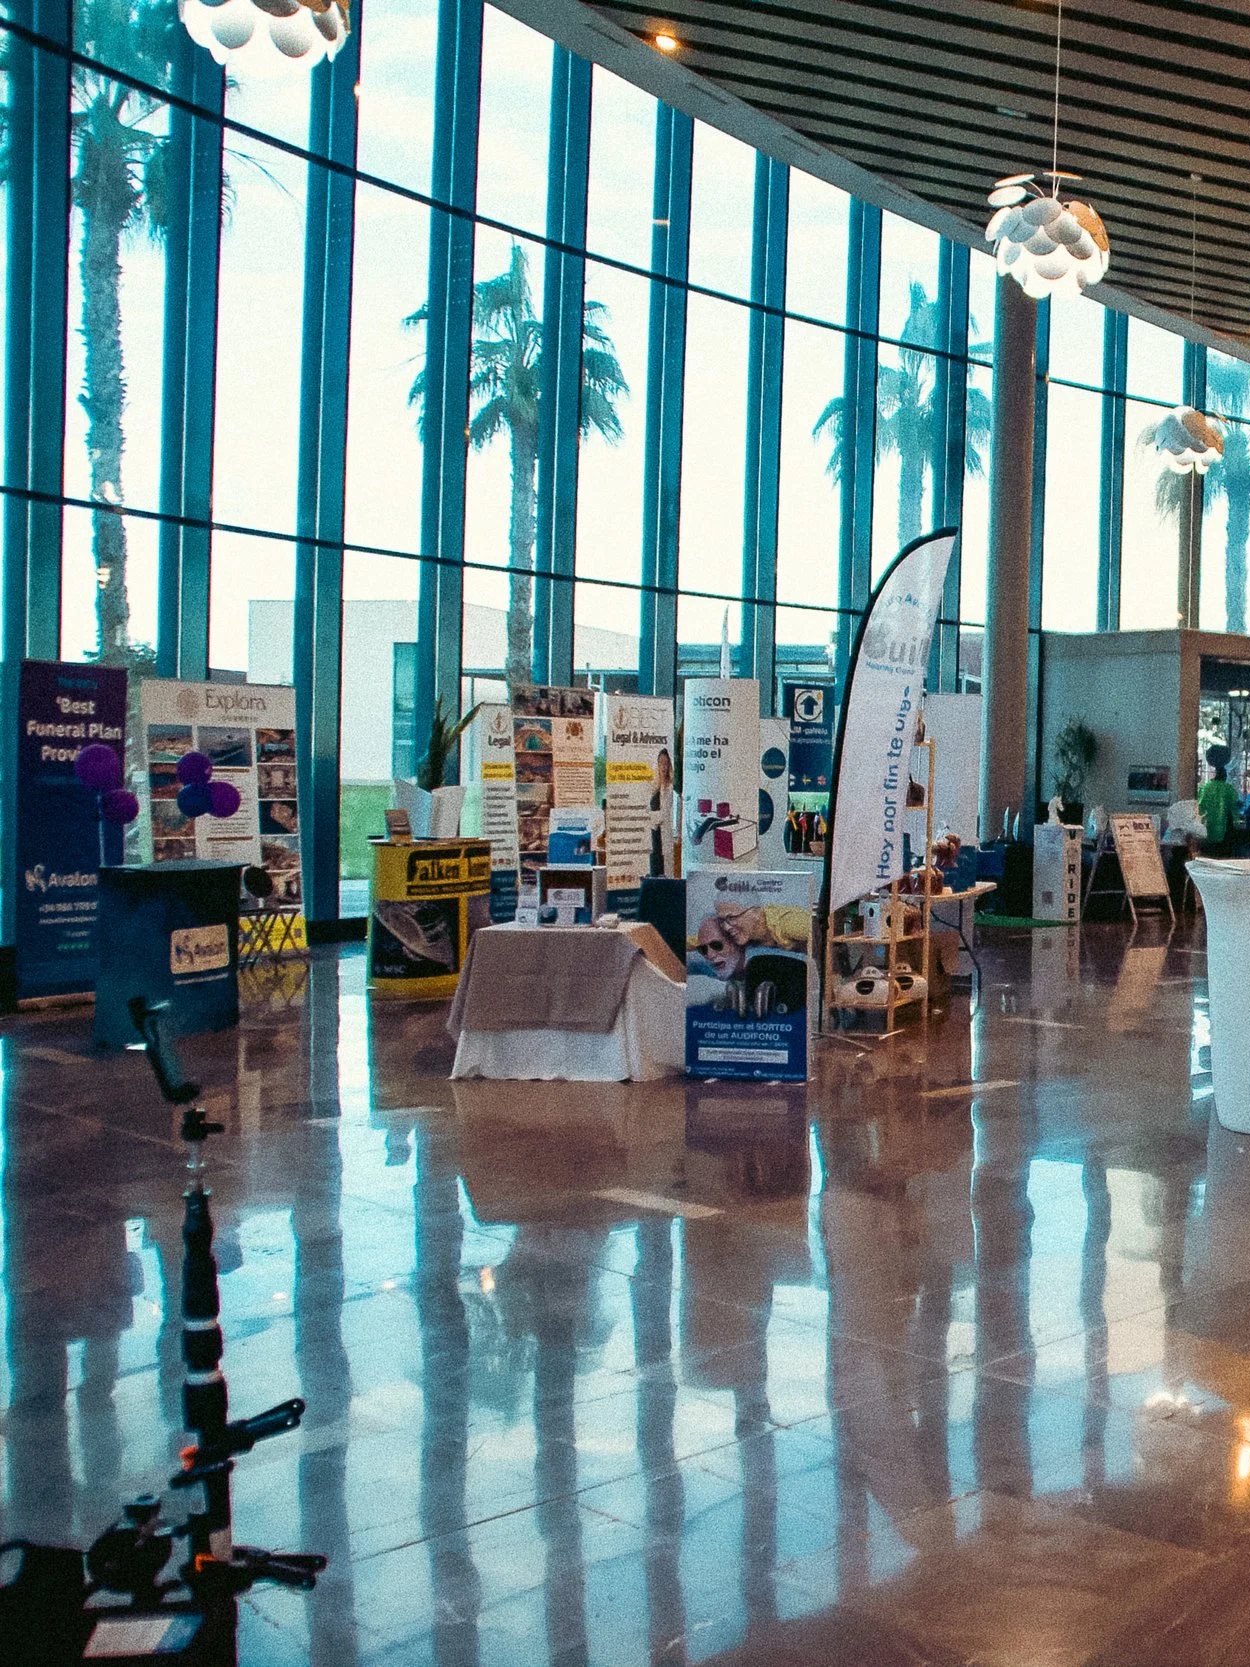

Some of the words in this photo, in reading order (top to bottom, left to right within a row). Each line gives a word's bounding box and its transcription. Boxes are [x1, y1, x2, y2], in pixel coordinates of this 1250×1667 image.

[205, 688, 267, 713] Explora
[27, 720, 85, 738] Funeral
[88, 723, 122, 740] Plan
[612, 731, 632, 747] Legal
[488, 735, 512, 751] Legal
[714, 735, 729, 746] ha
[887, 737, 904, 759] te
[710, 748, 722, 759] el
[883, 764, 899, 791] fin
[883, 797, 897, 833] por
[876, 839, 894, 880] Hoy
[692, 1020, 732, 1031] Participa
[733, 1022, 744, 1030] en
[745, 1022, 755, 1031] el
[756, 1022, 793, 1032] SORTEO
[704, 1031, 716, 1039] de
